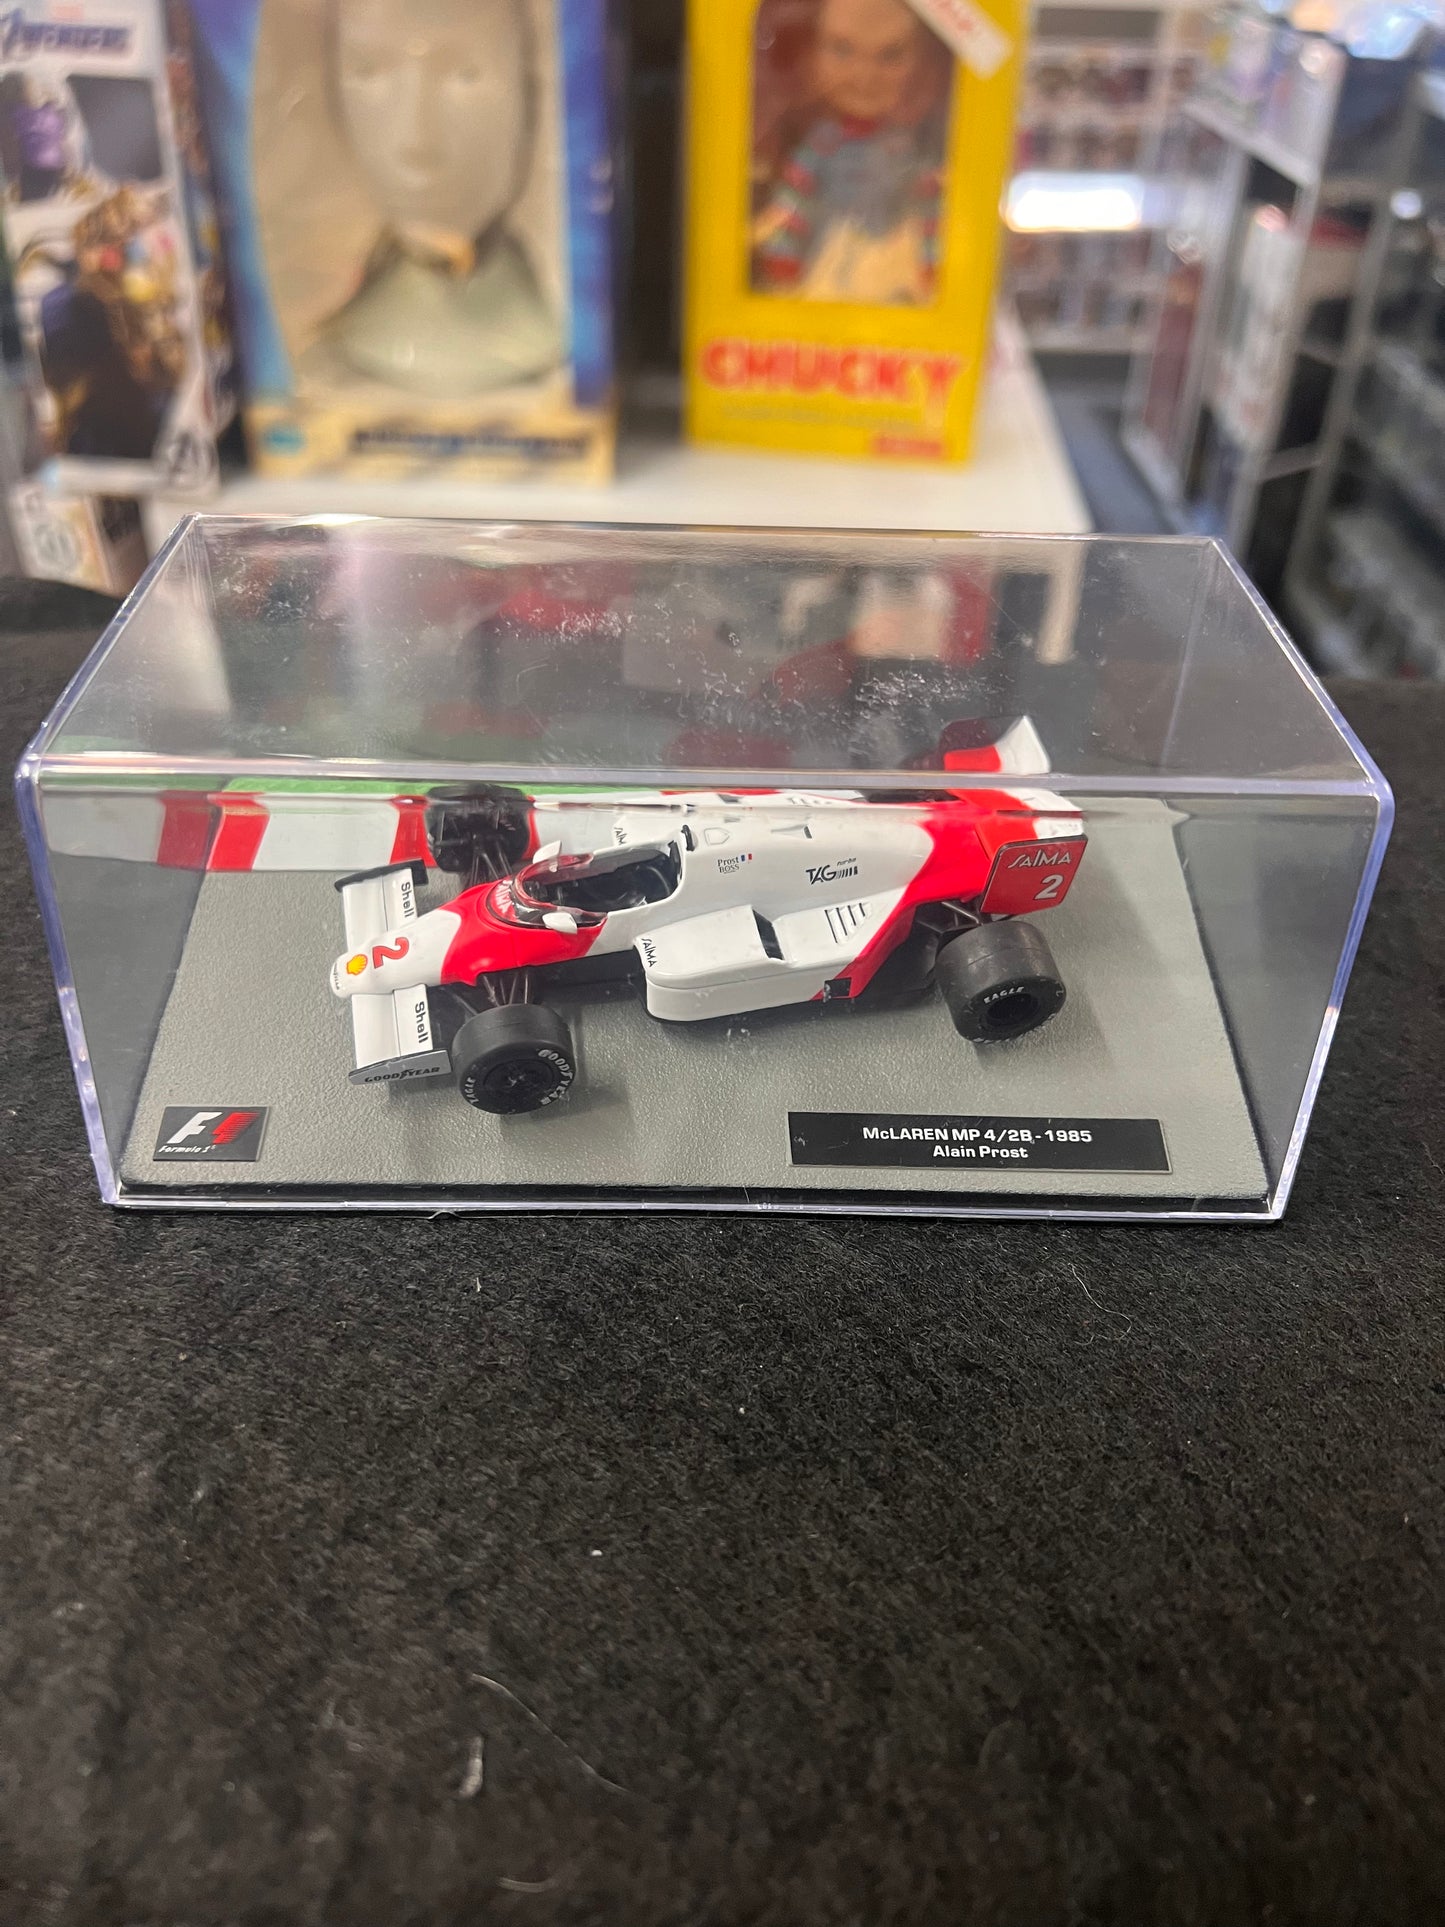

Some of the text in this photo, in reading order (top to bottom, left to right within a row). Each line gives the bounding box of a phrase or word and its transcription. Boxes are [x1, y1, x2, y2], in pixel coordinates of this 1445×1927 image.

[702, 338, 962, 410] CHUCKY
[717, 856, 739, 867] Prost
[719, 863, 740, 874] BOSS
[1033, 874, 1064, 901] 2
[401, 881, 415, 919] Shell
[372, 936, 410, 970] 2
[983, 986, 1025, 1004] EAGLE
[414, 1001, 429, 1044] Shell
[364, 1066, 441, 1083] GOODYEAR
[862, 1126, 950, 1142] McLAREN
[952, 1127, 981, 1142] MP
[983, 1128, 1032, 1144] 4/2B
[1044, 1129, 1093, 1143] 1985
[158, 1145, 202, 1153] Formula
[932, 1144, 1029, 1159] Alain Prost
